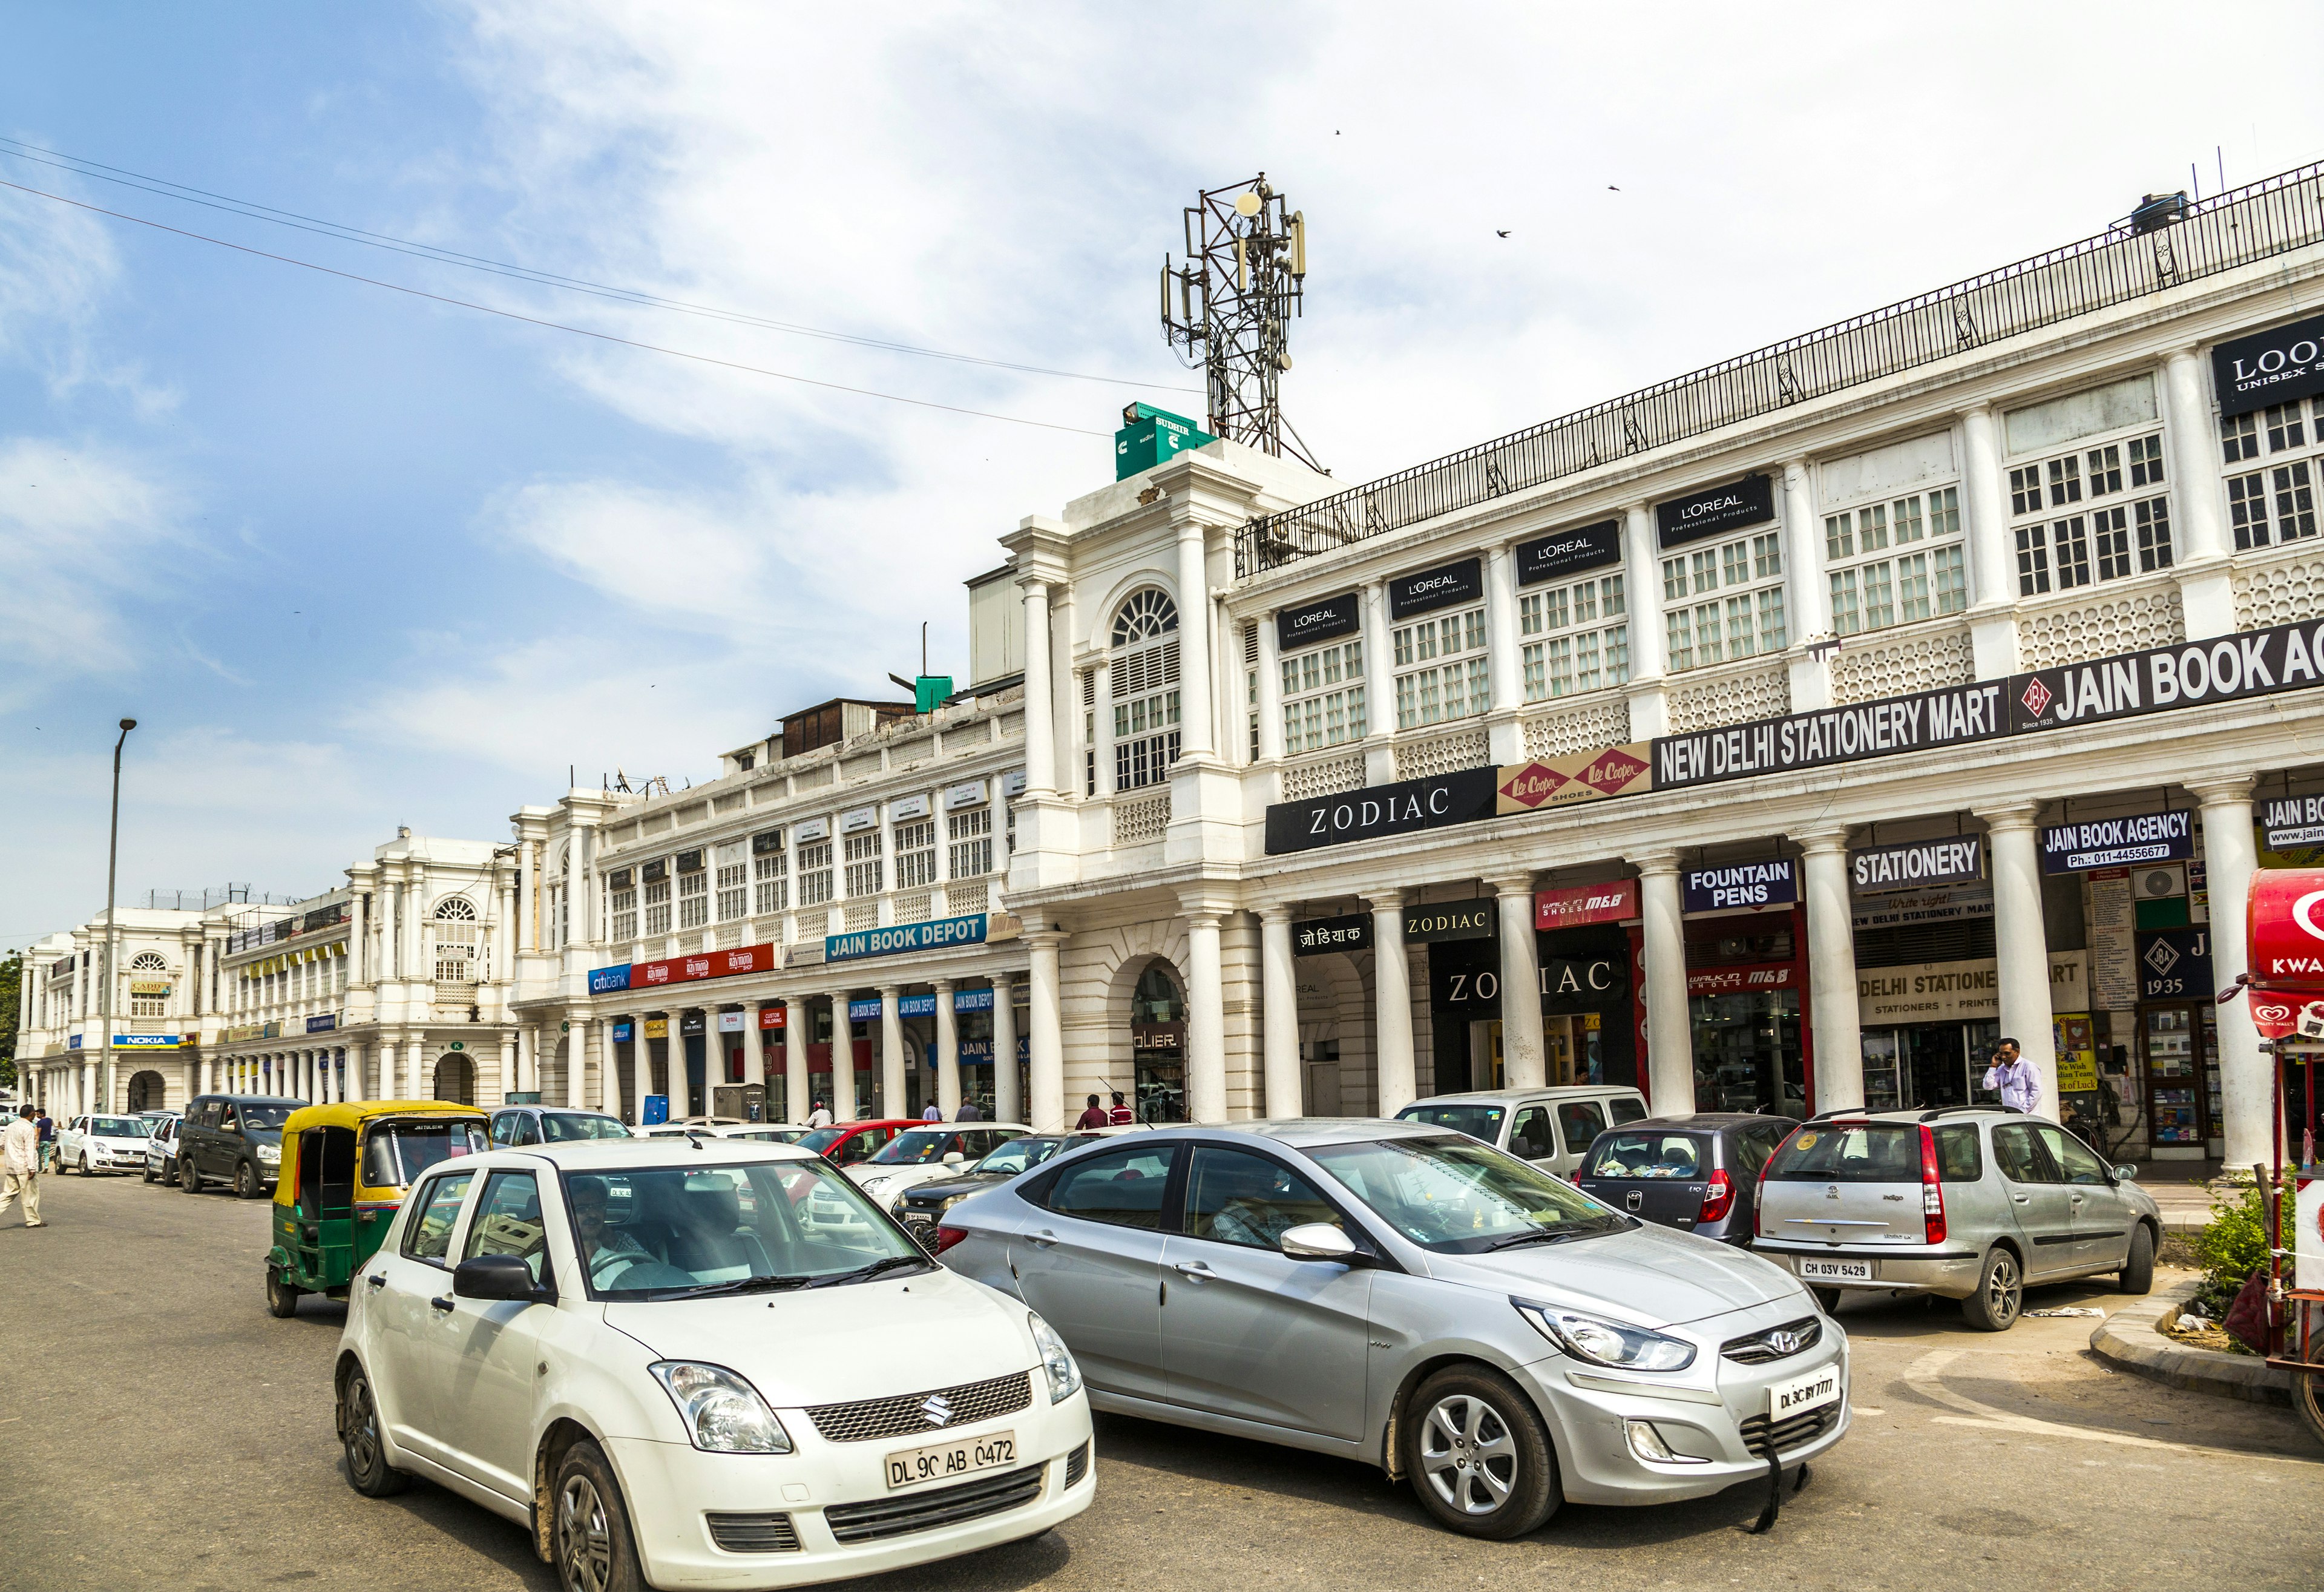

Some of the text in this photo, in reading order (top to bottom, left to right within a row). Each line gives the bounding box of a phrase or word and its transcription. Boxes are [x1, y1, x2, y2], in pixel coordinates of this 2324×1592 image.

[2233, 337, 2324, 381] LOO
[2236, 367, 2307, 391] UNISEX
[1156, 417, 1189, 436] SUDHIR
[1140, 433, 1155, 443] sudhir
[1671, 505, 1758, 533] Professional Products
[1529, 548, 1605, 571] Professional Products
[1400, 584, 1469, 606] Professional Products
[1287, 618, 1347, 637] Professional Products
[2055, 658, 2140, 721] JAIN
[2150, 634, 2275, 705] BOOK
[2027, 685, 2046, 710] JBA
[1661, 686, 1999, 783] NEW DELHI STATIONERY MART
[2022, 721, 2038, 729] Since
[1588, 763, 1639, 784] Lee Cooper
[1512, 776, 1560, 797] Lee Cooper
[1552, 790, 1593, 801] SHOES
[1310, 787, 1449, 834] ZODIAC
[2265, 800, 2301, 827] JAIN
[2046, 812, 2188, 853] JAIN BOOK AGENCY
[1856, 841, 1977, 886] STATIONERY
[2070, 846, 2167, 866] Ph.: 011-44556677
[1690, 862, 1789, 890] FOUNTAIN
[1713, 884, 1768, 907] PENS
[1888, 898, 1919, 909] Write
[1543, 906, 1582, 916] SHOES
[1873, 913, 1899, 924] DELHI
[1903, 906, 1962, 921] STATIONERY
[1408, 912, 1485, 933] ZODIAC
[832, 919, 979, 957] JAIN BOOK DEPOT
[729, 953, 753, 969] Raymond
[2155, 948, 2170, 965] JBA
[647, 966, 668, 981] Raymond
[686, 960, 709, 975] Raymond
[594, 972, 626, 990] citibank
[1449, 961, 1611, 1001] ZOIAC
[1688, 980, 1741, 989] SHOES
[1860, 978, 1907, 998] DELHI
[2147, 979, 2183, 995] 1935
[850, 1002, 881, 1018] JAIN BOOK DEPOT
[900, 998, 935, 1014] JAIN BOOK DEPOT
[955, 993, 993, 1010] JAIN BOOK DEPOT
[1876, 1002, 1939, 1014] STATIONERS
[962, 1043, 987, 1056] JAIN
[2068, 1081, 2076, 1089] of
[2077, 1079, 2096, 1089] Luck
[1805, 1263, 1866, 1277] CH 03V 5429
[1781, 1394, 1791, 1409] DL
[892, 1461, 915, 1484] DL
[946, 1450, 967, 1473] AB
[976, 1440, 1015, 1466] 0472
